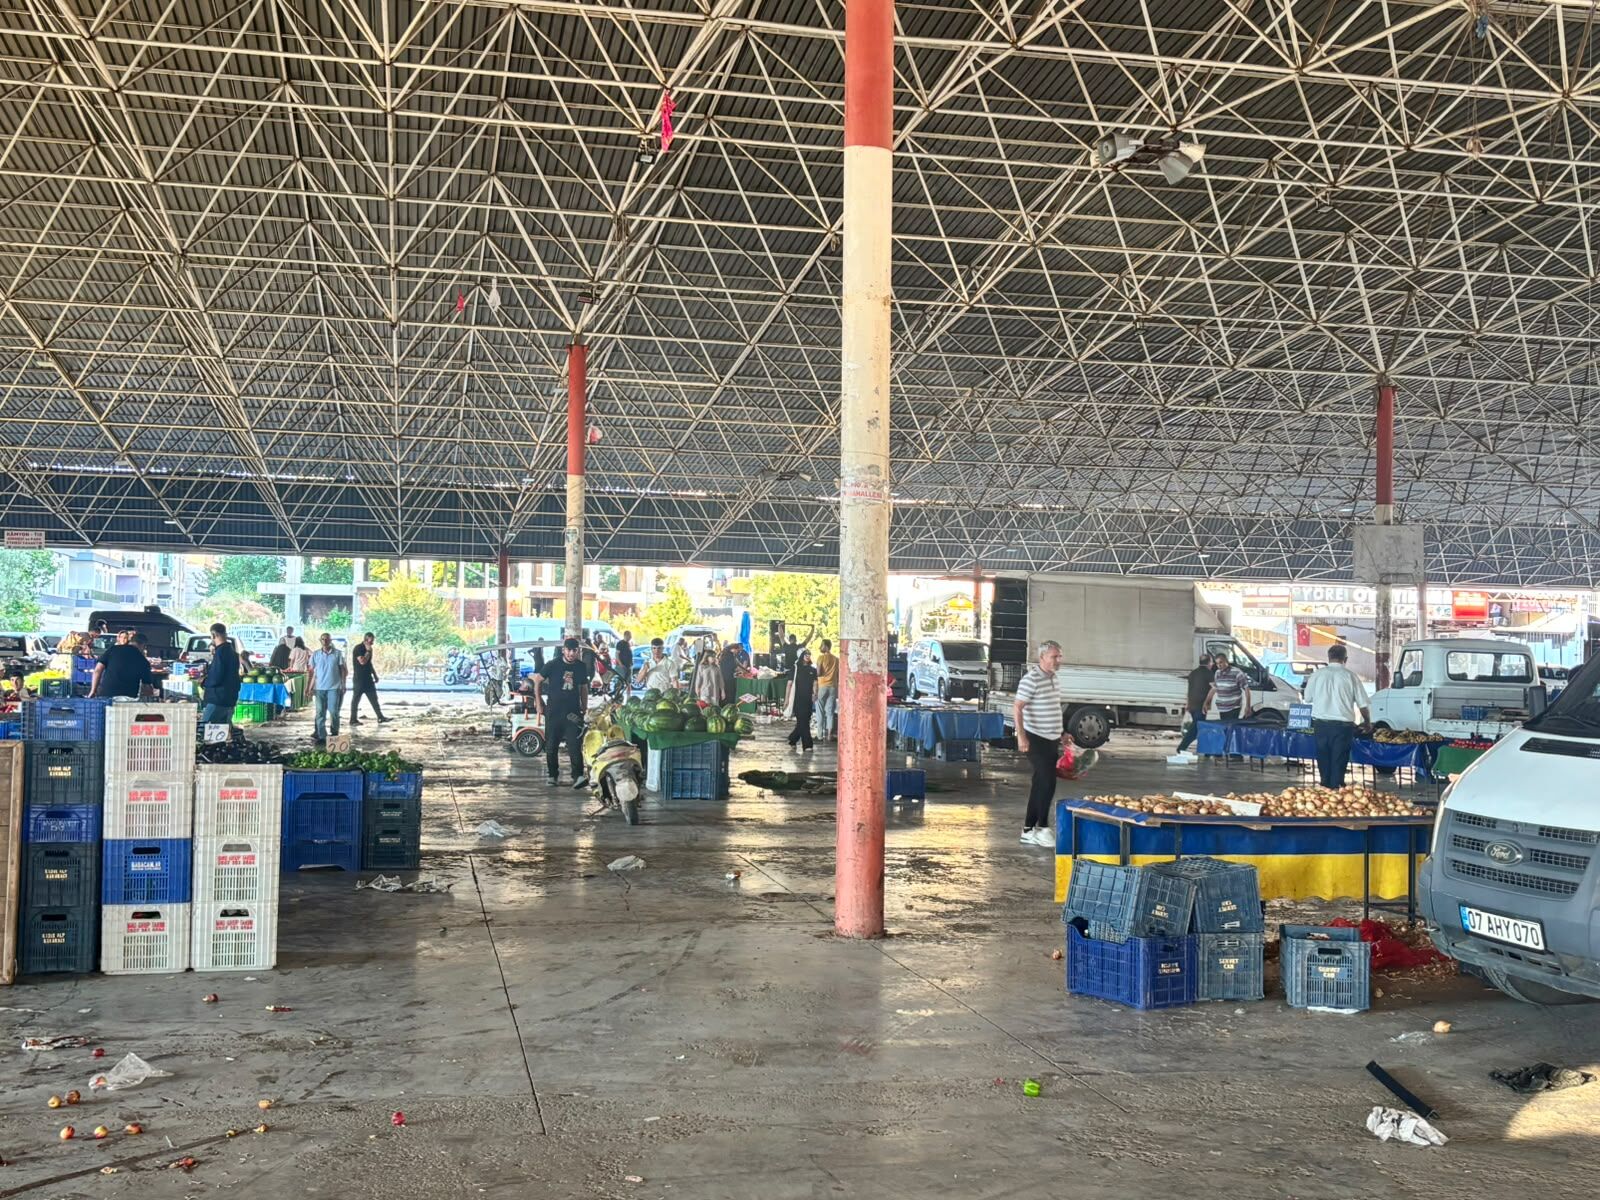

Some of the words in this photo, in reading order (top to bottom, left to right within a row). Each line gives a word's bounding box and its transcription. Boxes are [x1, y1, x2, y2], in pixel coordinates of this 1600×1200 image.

[1490, 844, 1512, 860] Ford
[1468, 910, 1482, 930] 07
[1487, 915, 1511, 938] AHY
[1513, 922, 1540, 946] 070
